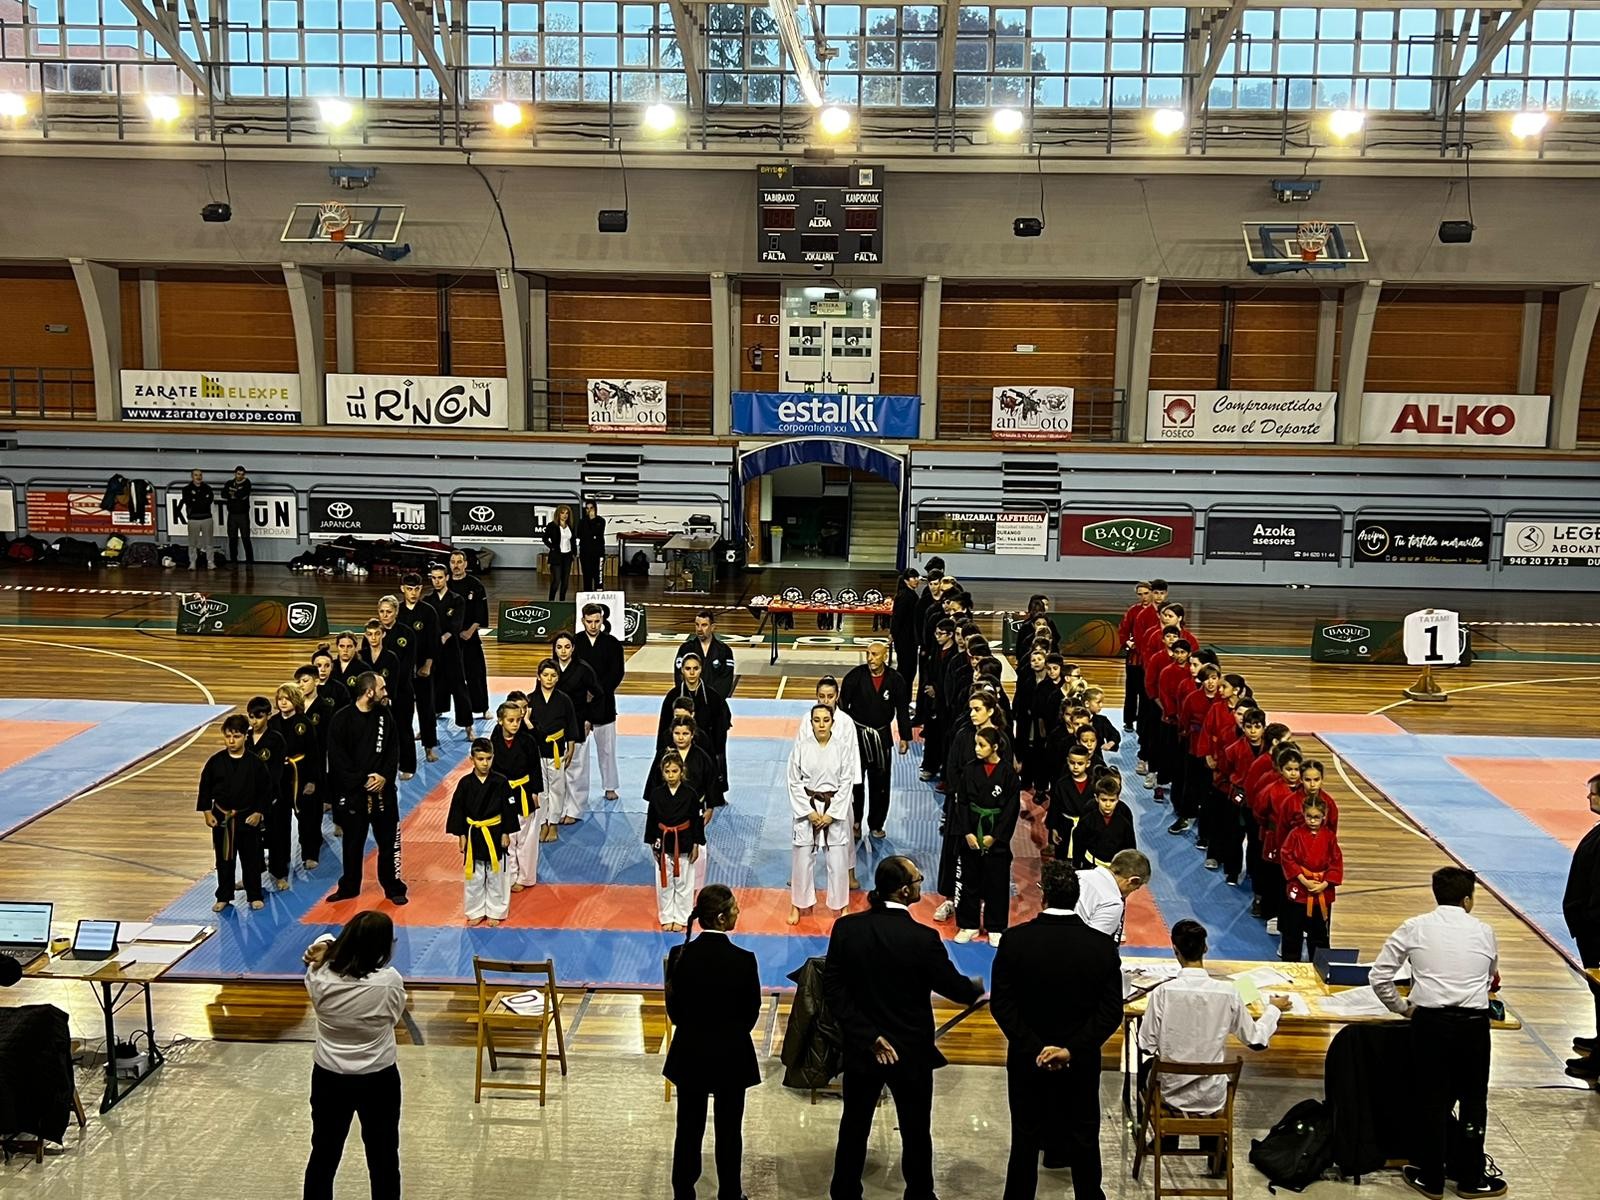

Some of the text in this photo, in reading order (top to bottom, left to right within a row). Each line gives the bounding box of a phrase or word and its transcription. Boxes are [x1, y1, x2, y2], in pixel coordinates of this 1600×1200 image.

[764, 193, 795, 202] TABIRAKO
[809, 219, 832, 228] ALDIA
[763, 252, 786, 261] FALTA
[855, 253, 878, 262] FALTA
[472, 380, 492, 390] bar
[135, 385, 288, 400] ZARATE ELEXPE
[346, 386, 367, 420] EL
[1212, 395, 1322, 415] Comprometidos
[128, 409, 296, 422] www.zarateyelexpe.com
[778, 395, 878, 431] estalki
[1390, 404, 1516, 436] AL-KO
[778, 424, 831, 433] corporation
[1161, 430, 1195, 438] FOSECO
[1212, 418, 1321, 438] con el Deporte
[392, 502, 426, 524] TTM
[952, 513, 1043, 522] IBAIZABAL KAFETEGIA
[462, 524, 503, 532] JAPANCAR
[1094, 526, 1161, 542] BAQUÉ
[1252, 524, 1296, 536] Azoka
[1394, 535, 1406, 547] Tu
[1408, 534, 1438, 548] tortilla
[1424, 626, 1444, 661] 1
